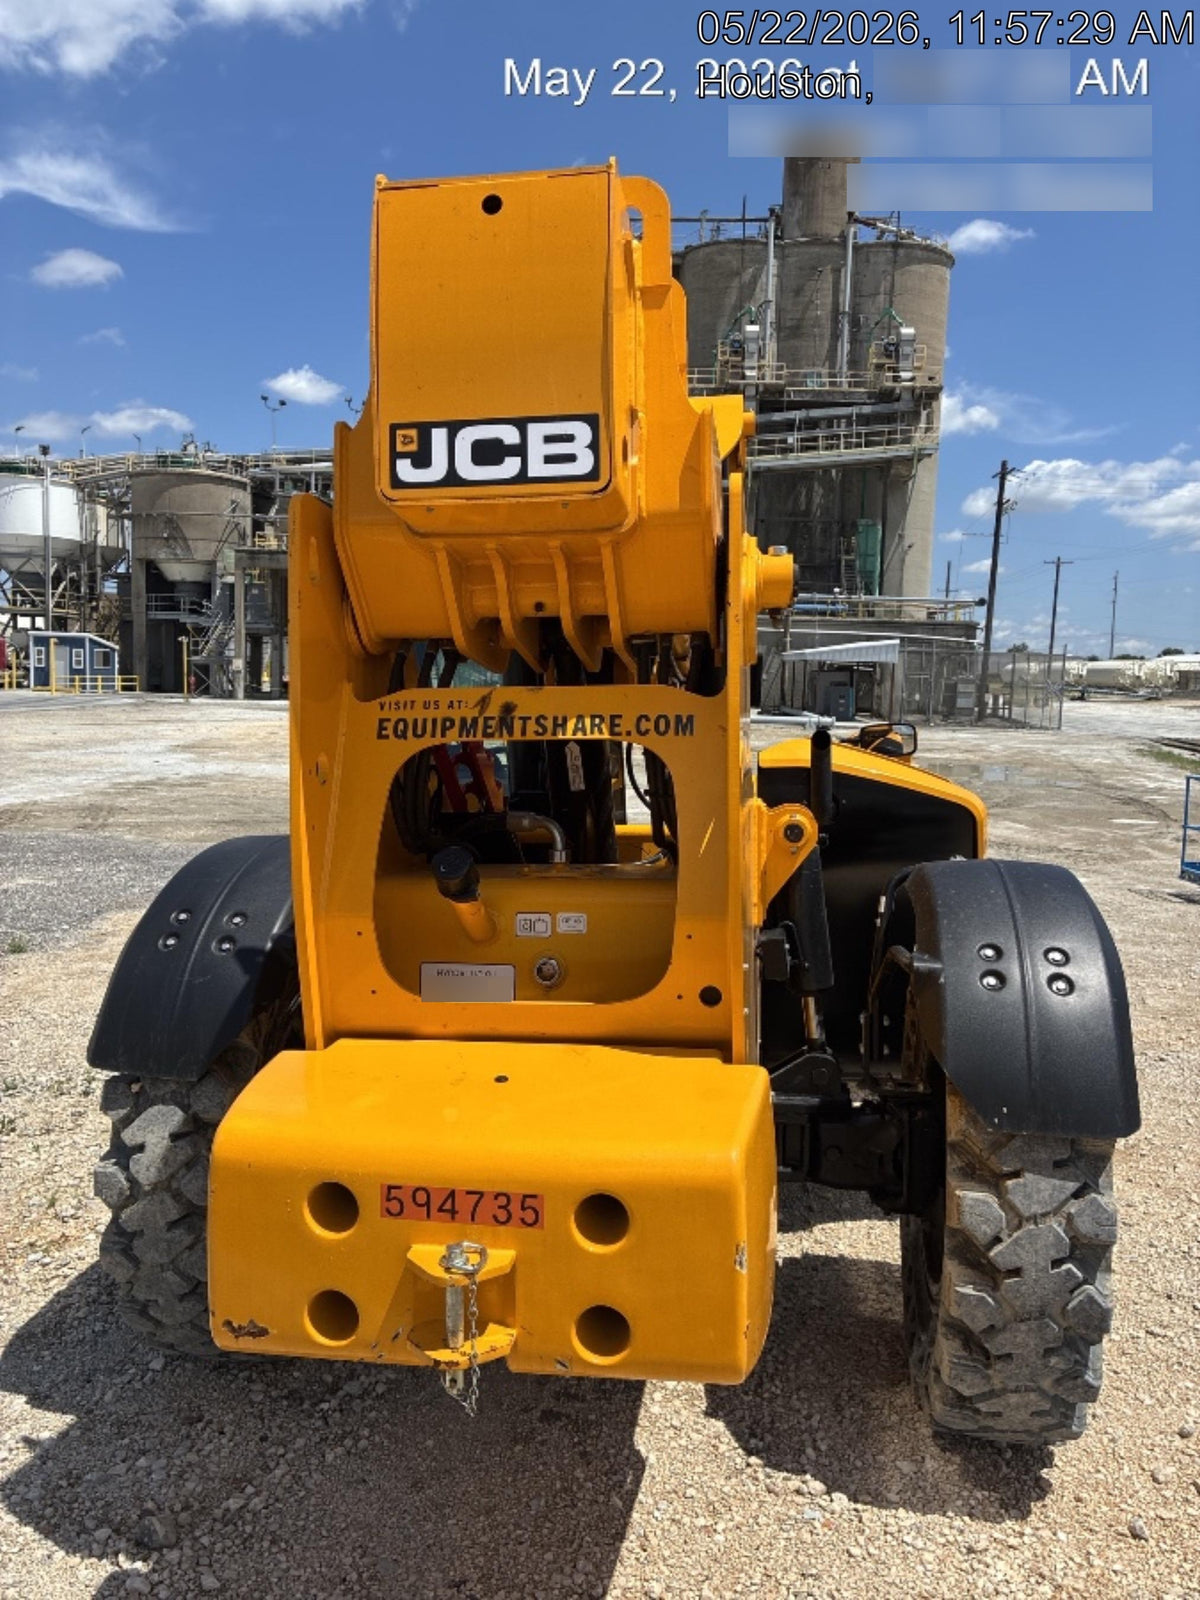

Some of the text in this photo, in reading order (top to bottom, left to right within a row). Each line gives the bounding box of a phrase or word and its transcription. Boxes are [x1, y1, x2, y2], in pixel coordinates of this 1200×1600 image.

[396, 421, 595, 483] JCB
[379, 700, 469, 711] VISIT US AT:
[376, 714, 695, 740] EQUIPMENTSHARE.COM
[384, 1184, 540, 1227] 594735
